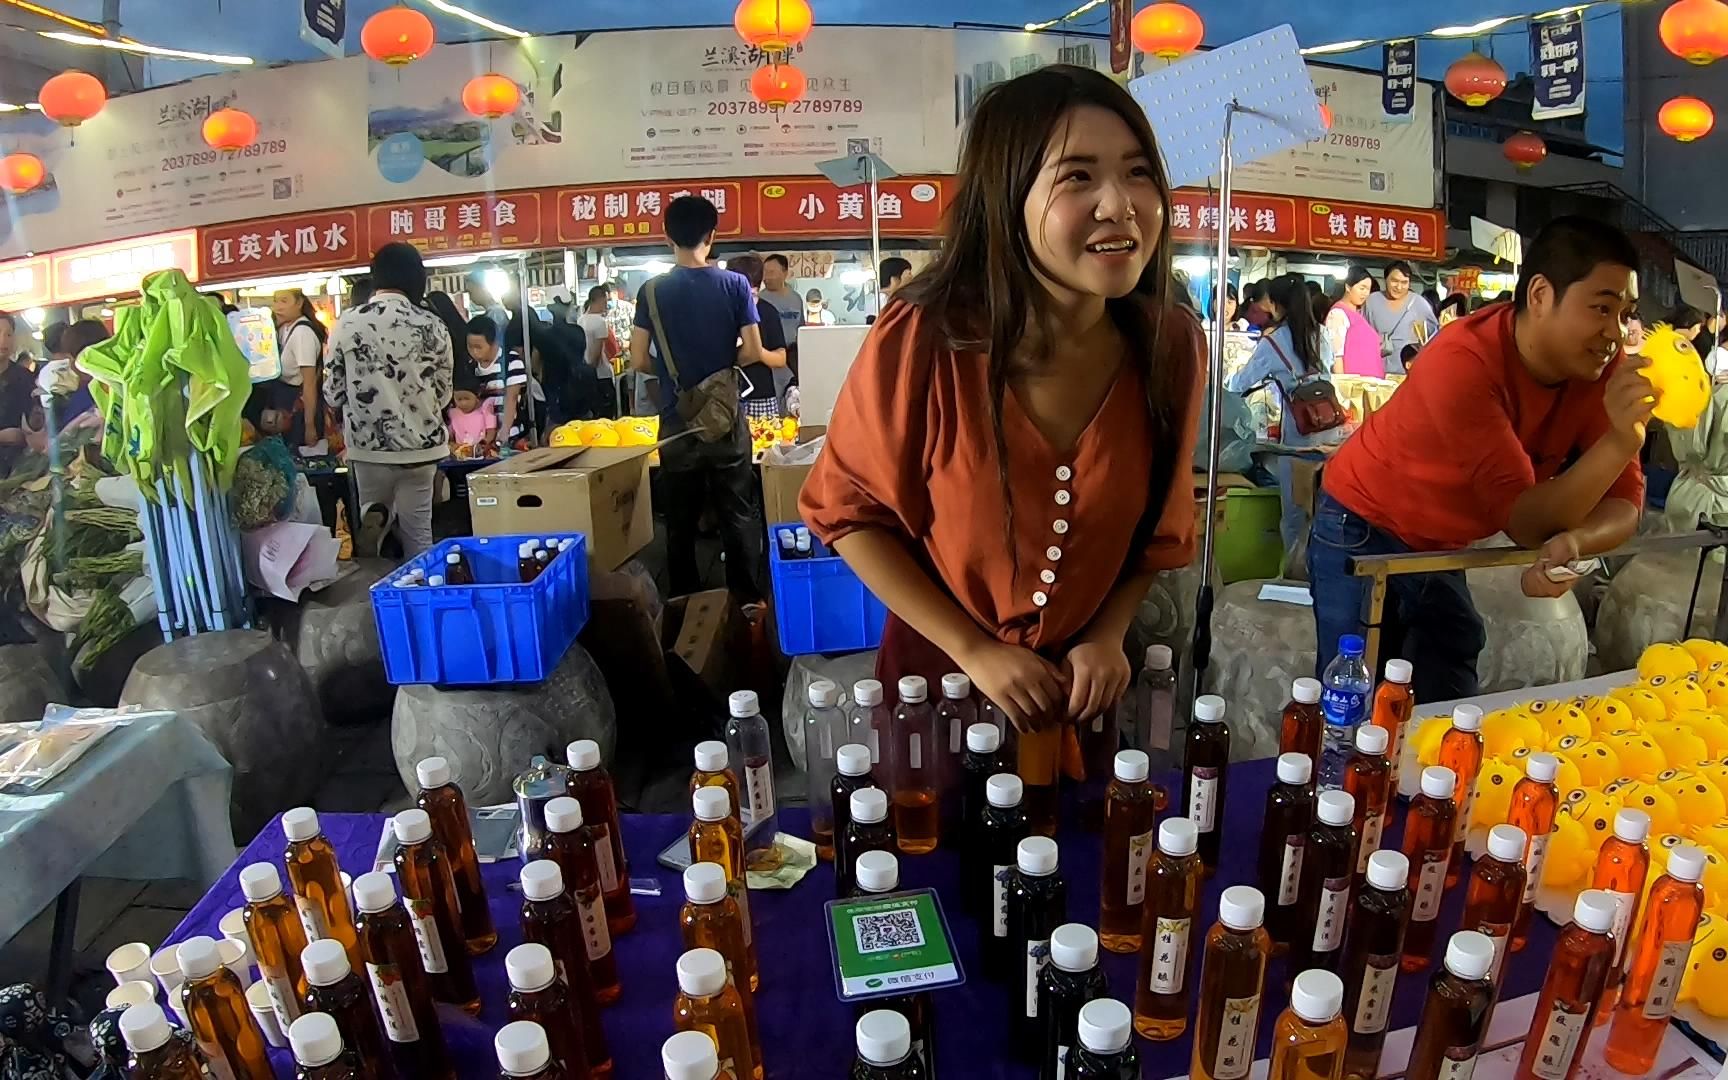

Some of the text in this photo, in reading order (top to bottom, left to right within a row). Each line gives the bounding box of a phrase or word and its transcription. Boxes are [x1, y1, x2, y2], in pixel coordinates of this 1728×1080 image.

[798, 192, 903, 221] 小黄鱼
[211, 222, 349, 266] 红英木瓜水
[1327, 212, 1421, 244] 铁板鱿鱼
